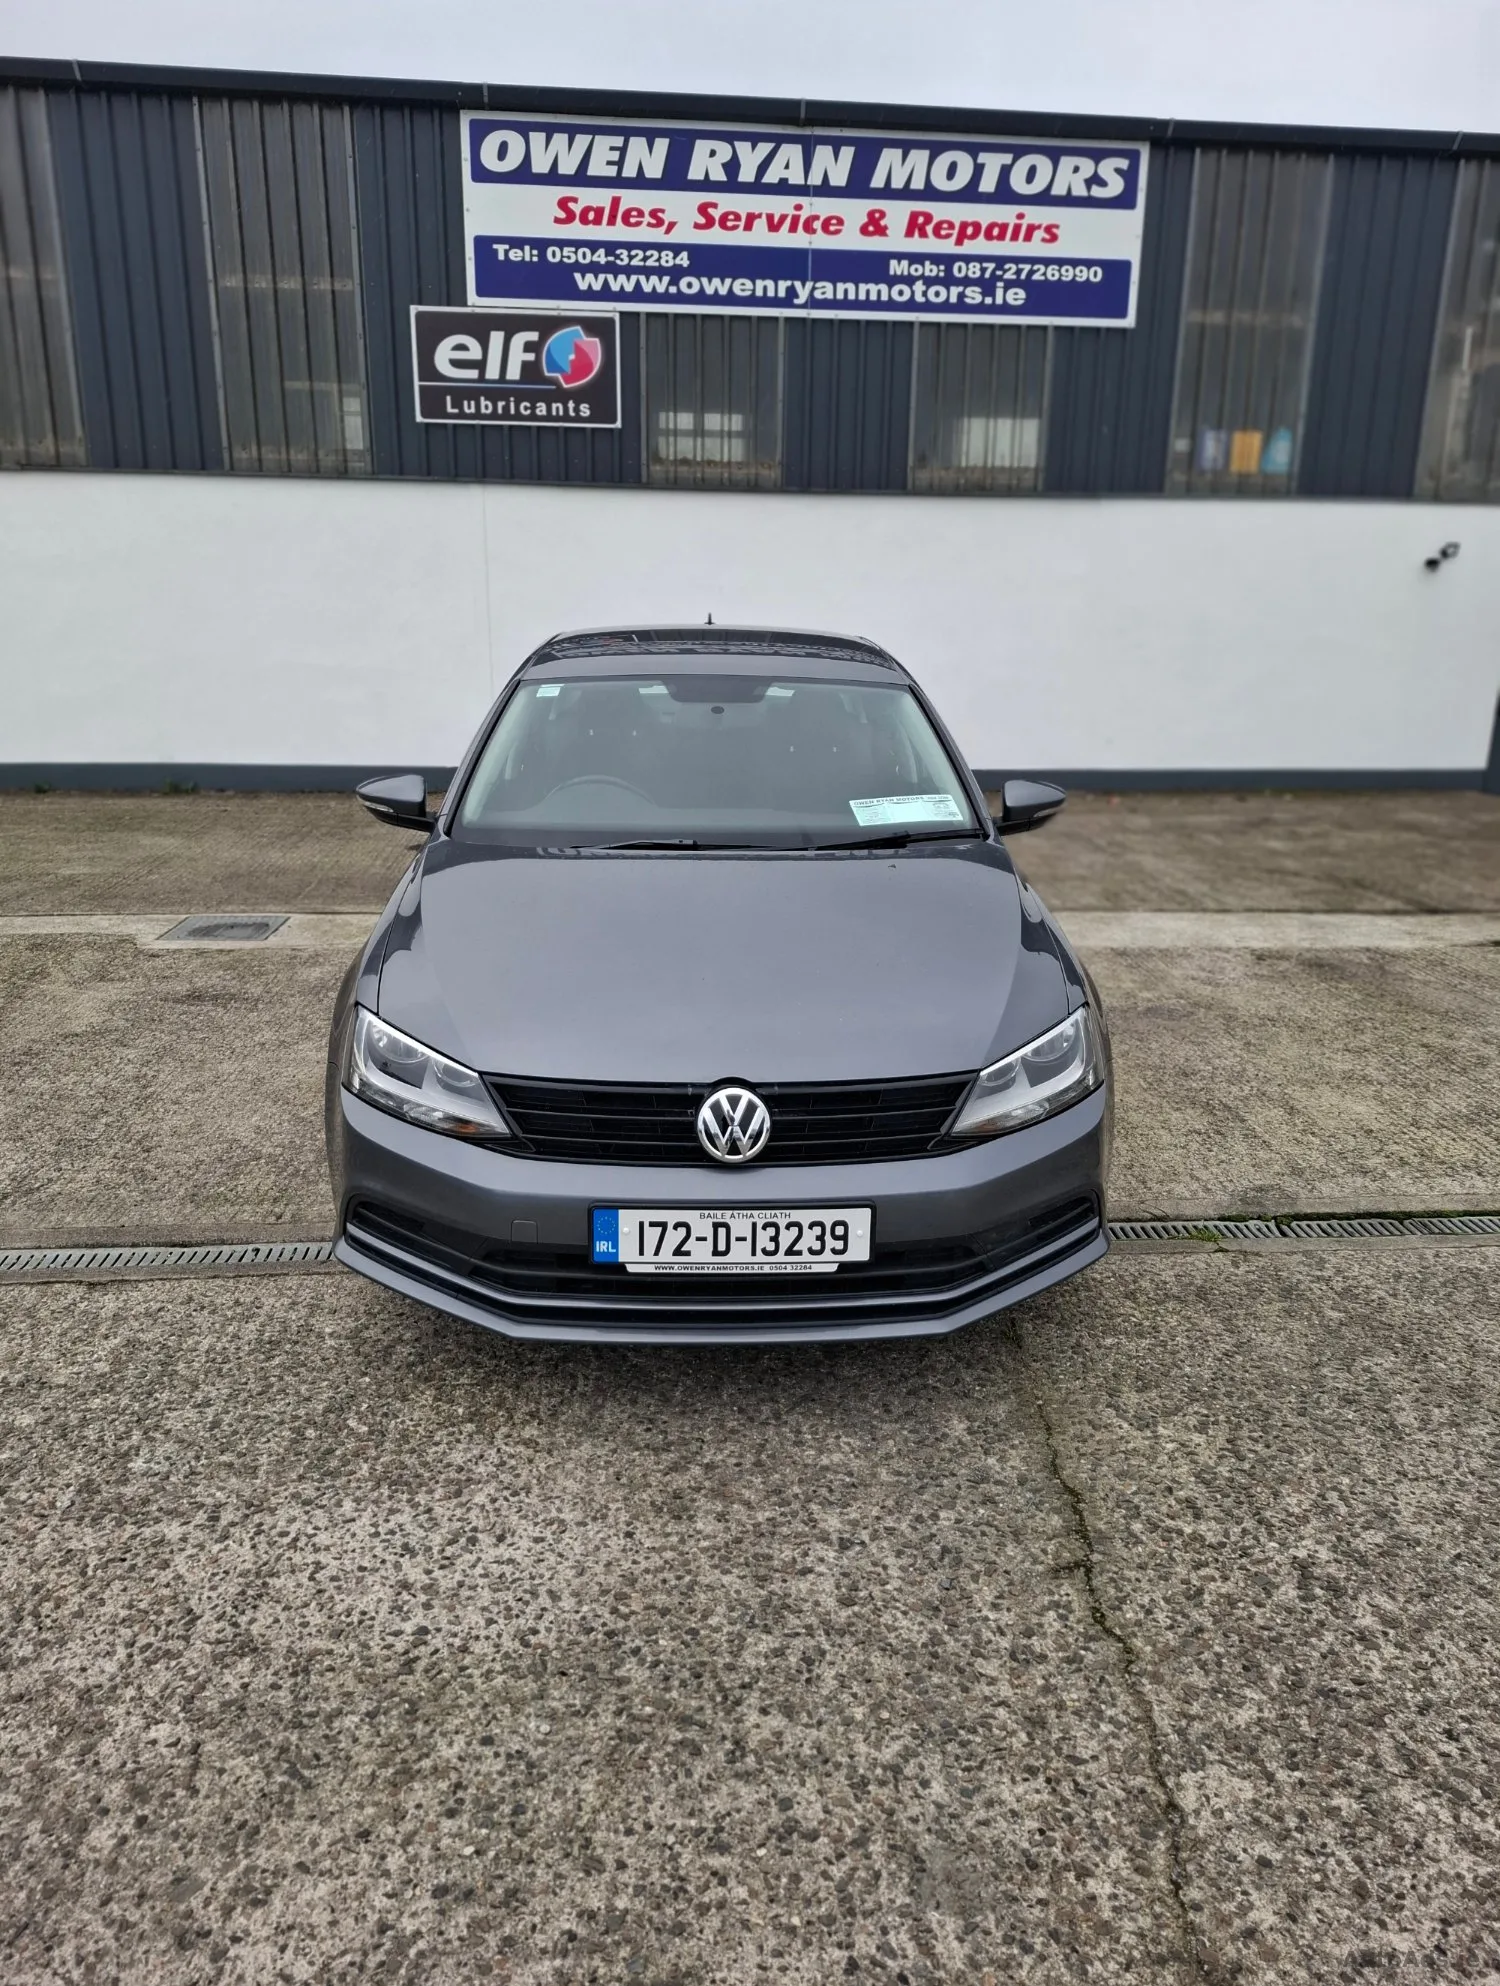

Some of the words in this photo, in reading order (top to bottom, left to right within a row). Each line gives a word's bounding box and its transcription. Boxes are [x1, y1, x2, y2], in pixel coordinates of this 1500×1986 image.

[479, 129, 670, 179] OWEN
[687, 139, 856, 187] RYAN
[869, 148, 1130, 199] MOTORS
[553, 195, 679, 235] Sales,
[692, 201, 845, 236] Service
[859, 208, 890, 238] &
[904, 210, 1061, 247] Repairs
[492, 244, 539, 263] Tel:
[546, 246, 690, 268] 0504-32284
[889, 259, 946, 277] Mob:
[953, 261, 1103, 283] 087-2726990
[573, 272, 1027, 306] www.owenryanmotors.ie
[434, 330, 539, 381] elf
[446, 395, 591, 417] Lubricants
[699, 1212, 727, 1220] BAILE
[596, 1240, 616, 1253] IRL
[638, 1219, 849, 1257] 172-D-13239
